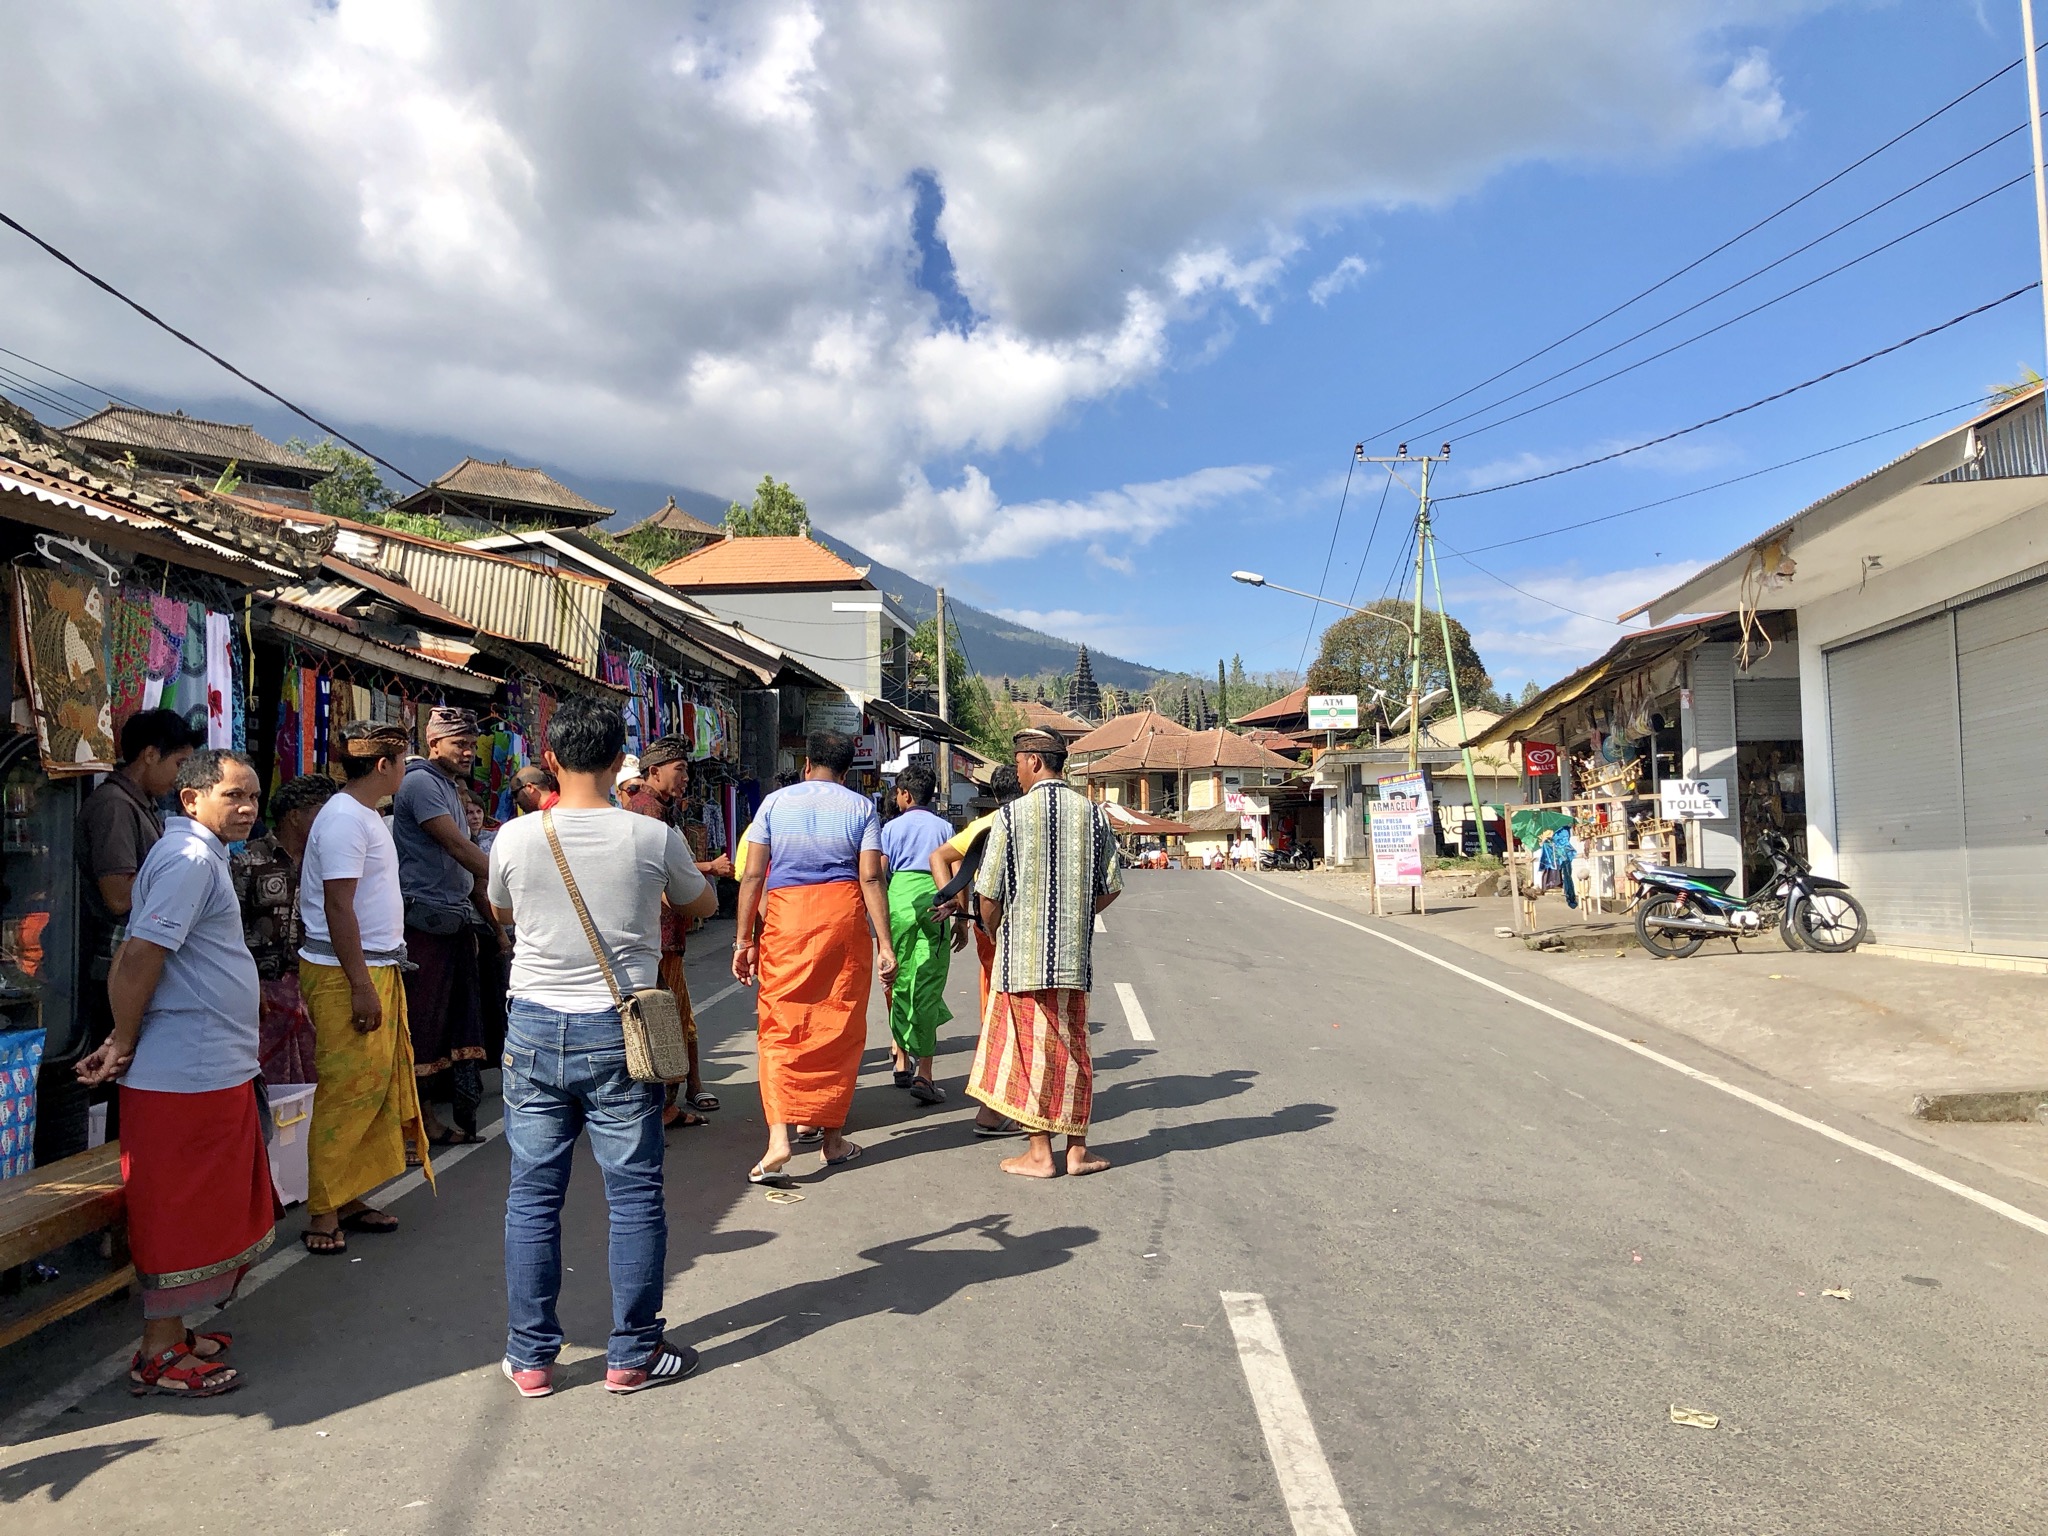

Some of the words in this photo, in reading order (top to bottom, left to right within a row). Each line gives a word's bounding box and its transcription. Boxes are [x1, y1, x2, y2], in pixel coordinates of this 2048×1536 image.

[1323, 698, 1343, 706] ATM
[917, 754, 931, 762] WC
[1530, 763, 1555, 771] WALL'S
[1678, 781, 1710, 796] WC
[1227, 793, 1246, 805] WC
[1667, 798, 1722, 810] TOILET
[1373, 802, 1395, 812] ARMA
[1395, 801, 1414, 811] CELL
